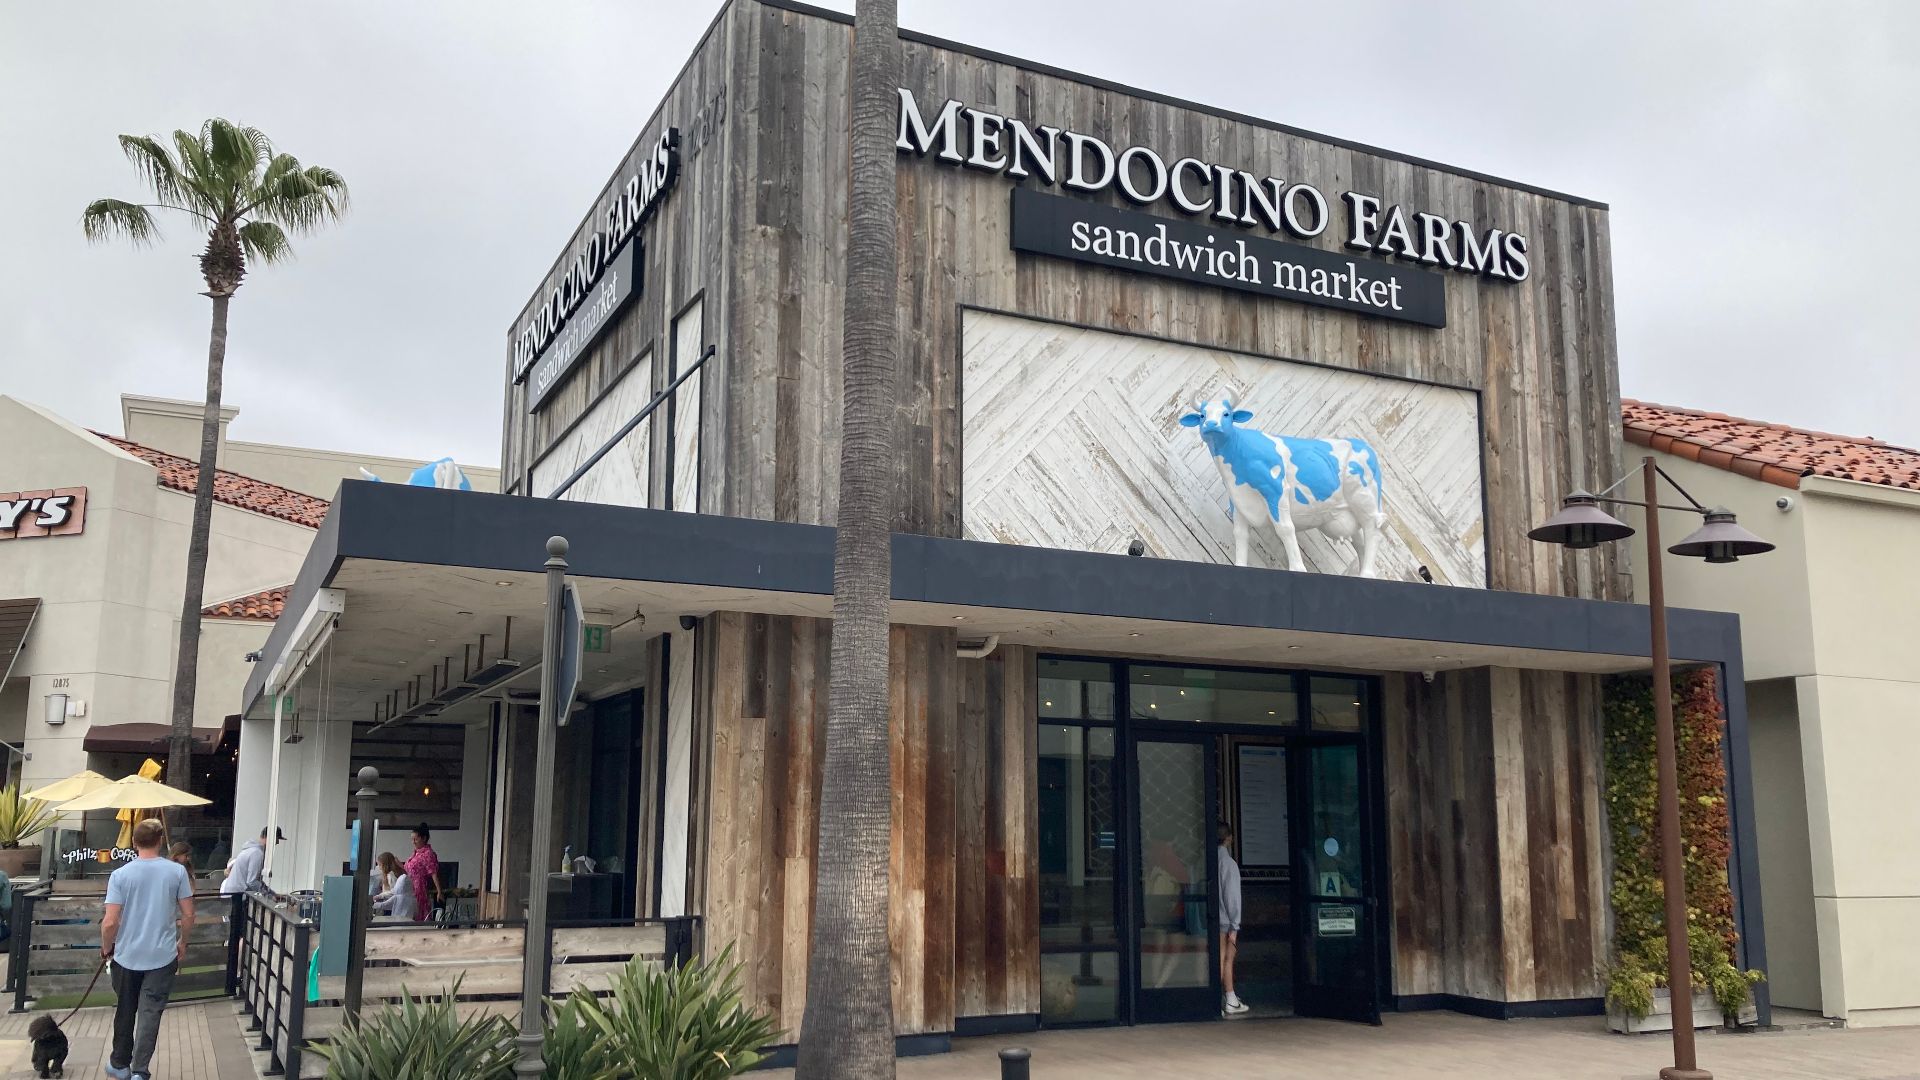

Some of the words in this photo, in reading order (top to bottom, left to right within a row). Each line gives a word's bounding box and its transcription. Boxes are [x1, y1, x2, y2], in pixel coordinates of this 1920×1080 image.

[896, 86, 1329, 239] MENDOCINO
[1344, 190, 1529, 283] FARMS
[513, 232, 603, 384] MENDOCINO
[603, 129, 675, 267] FARMS
[1071, 220, 1262, 285] sandwich
[1272, 261, 1403, 311] market
[537, 320, 579, 395] sandwich
[579, 271, 618, 345] market
[0, 495, 75, 529] Y'S
[62, 847, 98, 865] Philz
[110, 846, 139, 862] Coffe
[1325, 876, 1337, 893] A
